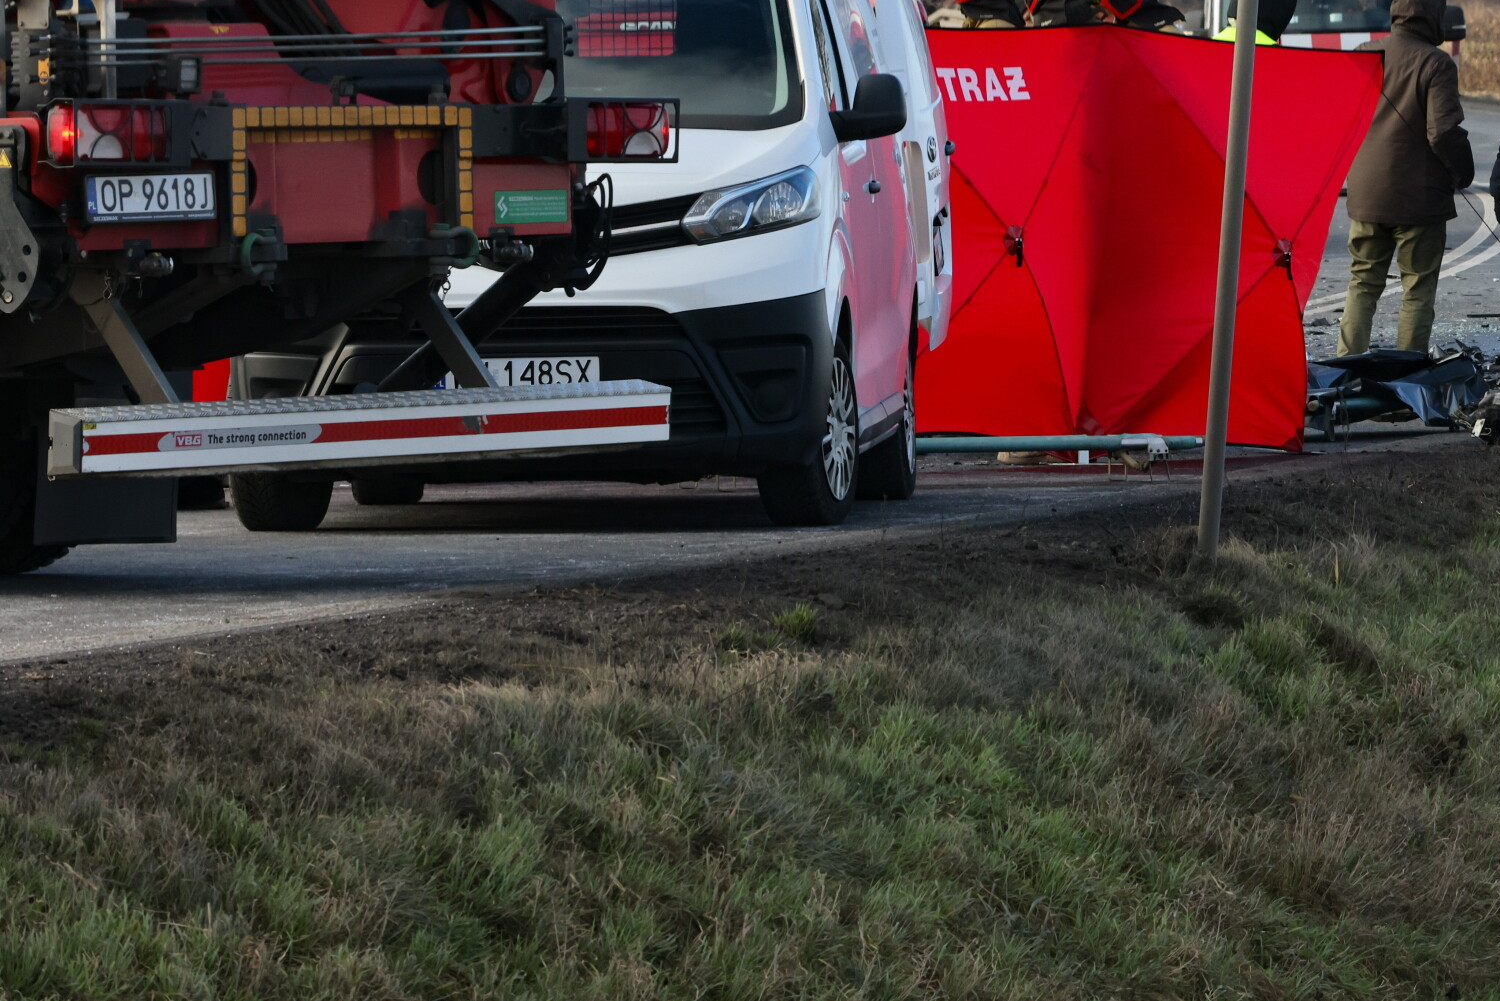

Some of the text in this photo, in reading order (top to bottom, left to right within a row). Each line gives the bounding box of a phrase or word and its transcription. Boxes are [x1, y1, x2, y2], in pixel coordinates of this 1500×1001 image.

[935, 66, 1031, 102] TRAŻ
[87, 201, 97, 210] PL
[101, 177, 209, 212] OP 9618J
[176, 429, 307, 446] VBG The strong connection
